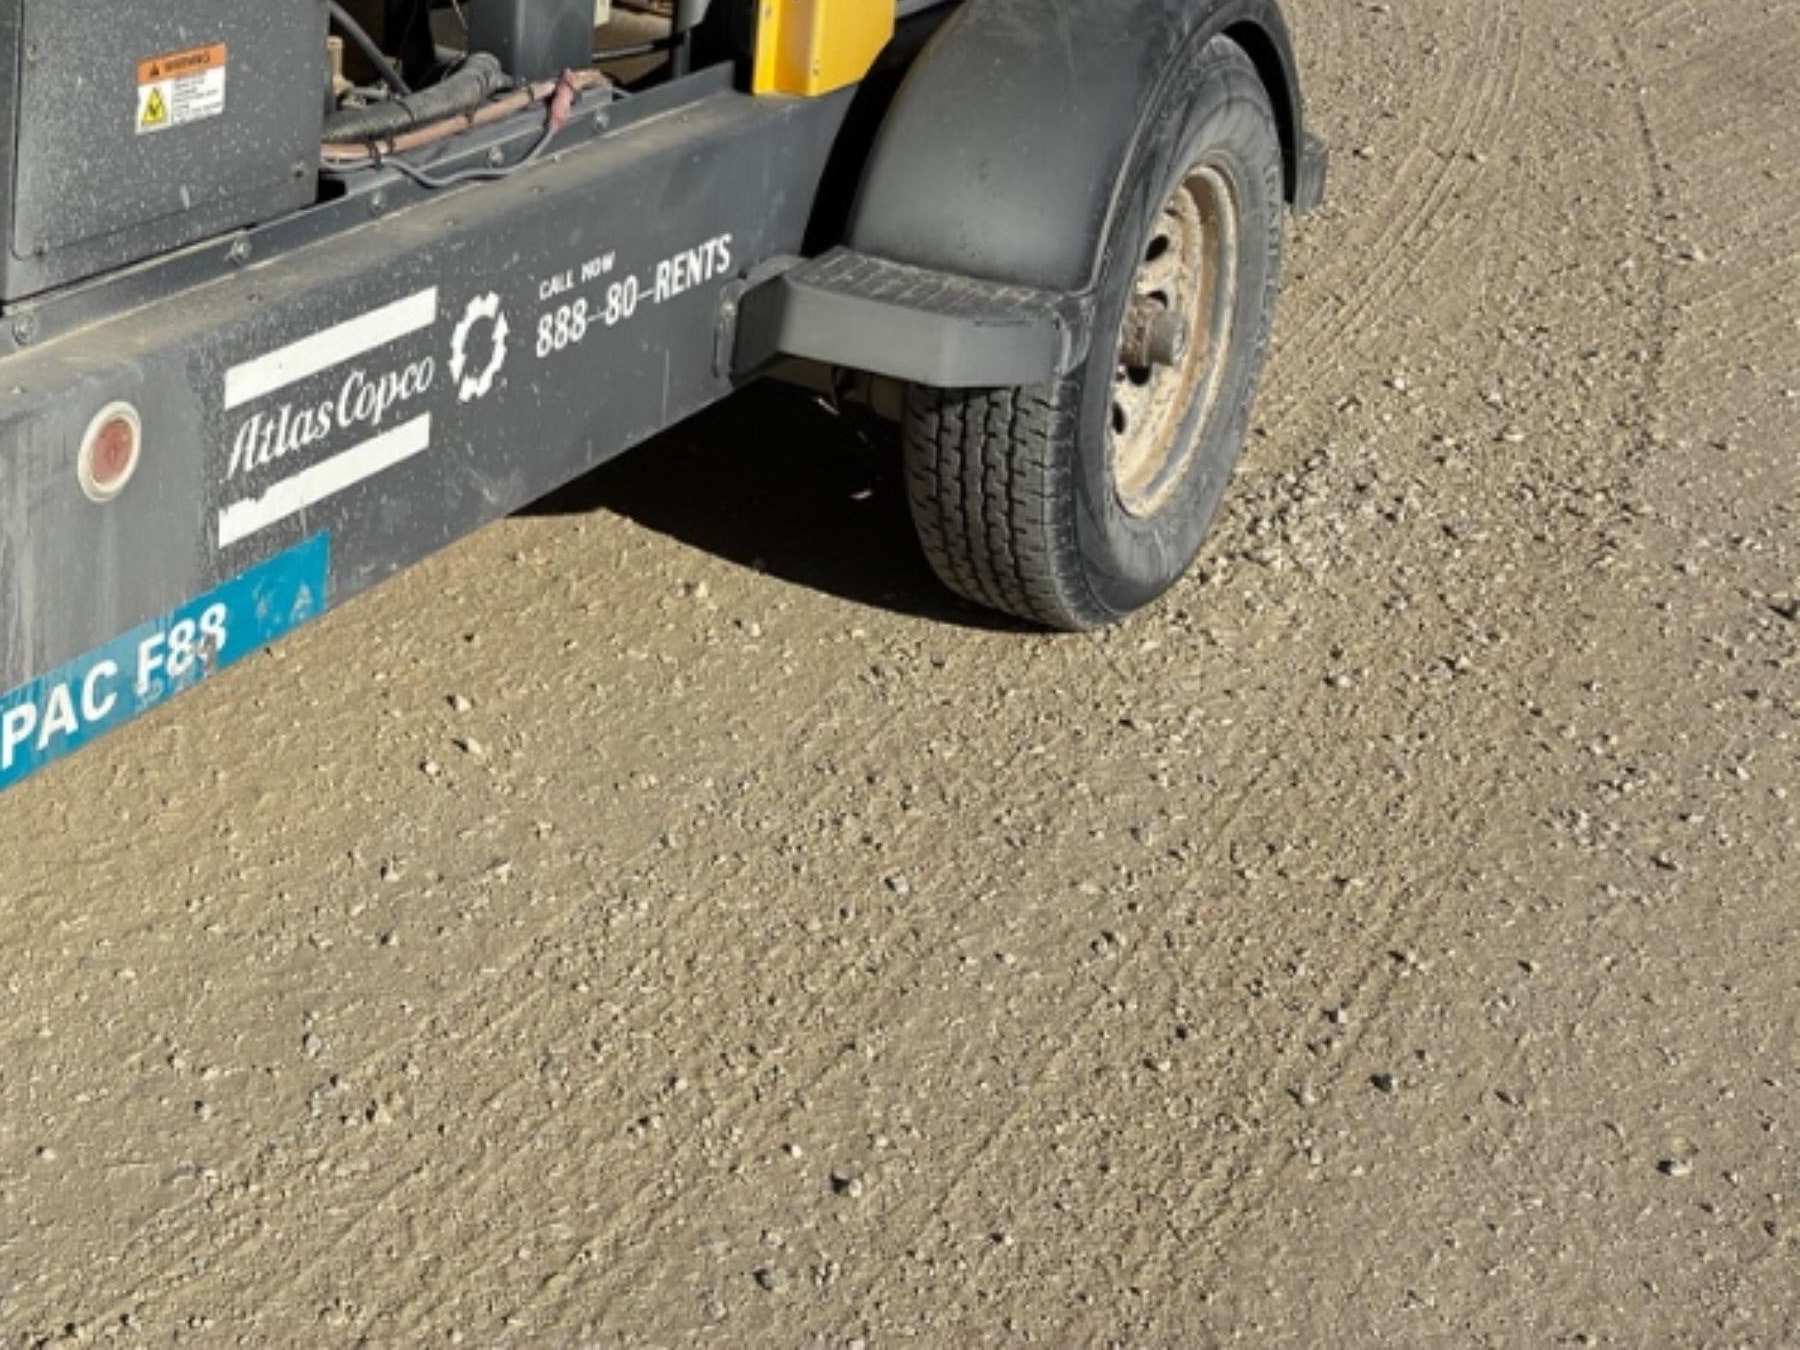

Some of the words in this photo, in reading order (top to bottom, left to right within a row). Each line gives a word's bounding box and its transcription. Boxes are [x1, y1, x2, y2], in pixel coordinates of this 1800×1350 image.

[535, 233, 734, 359] 888-80-RENTS
[538, 272, 575, 302] CALL
[580, 251, 617, 281] NOW
[219, 396, 335, 484] Atlas
[335, 355, 435, 430] Copco
[1, 658, 119, 771] PAC
[136, 601, 228, 698] F88
